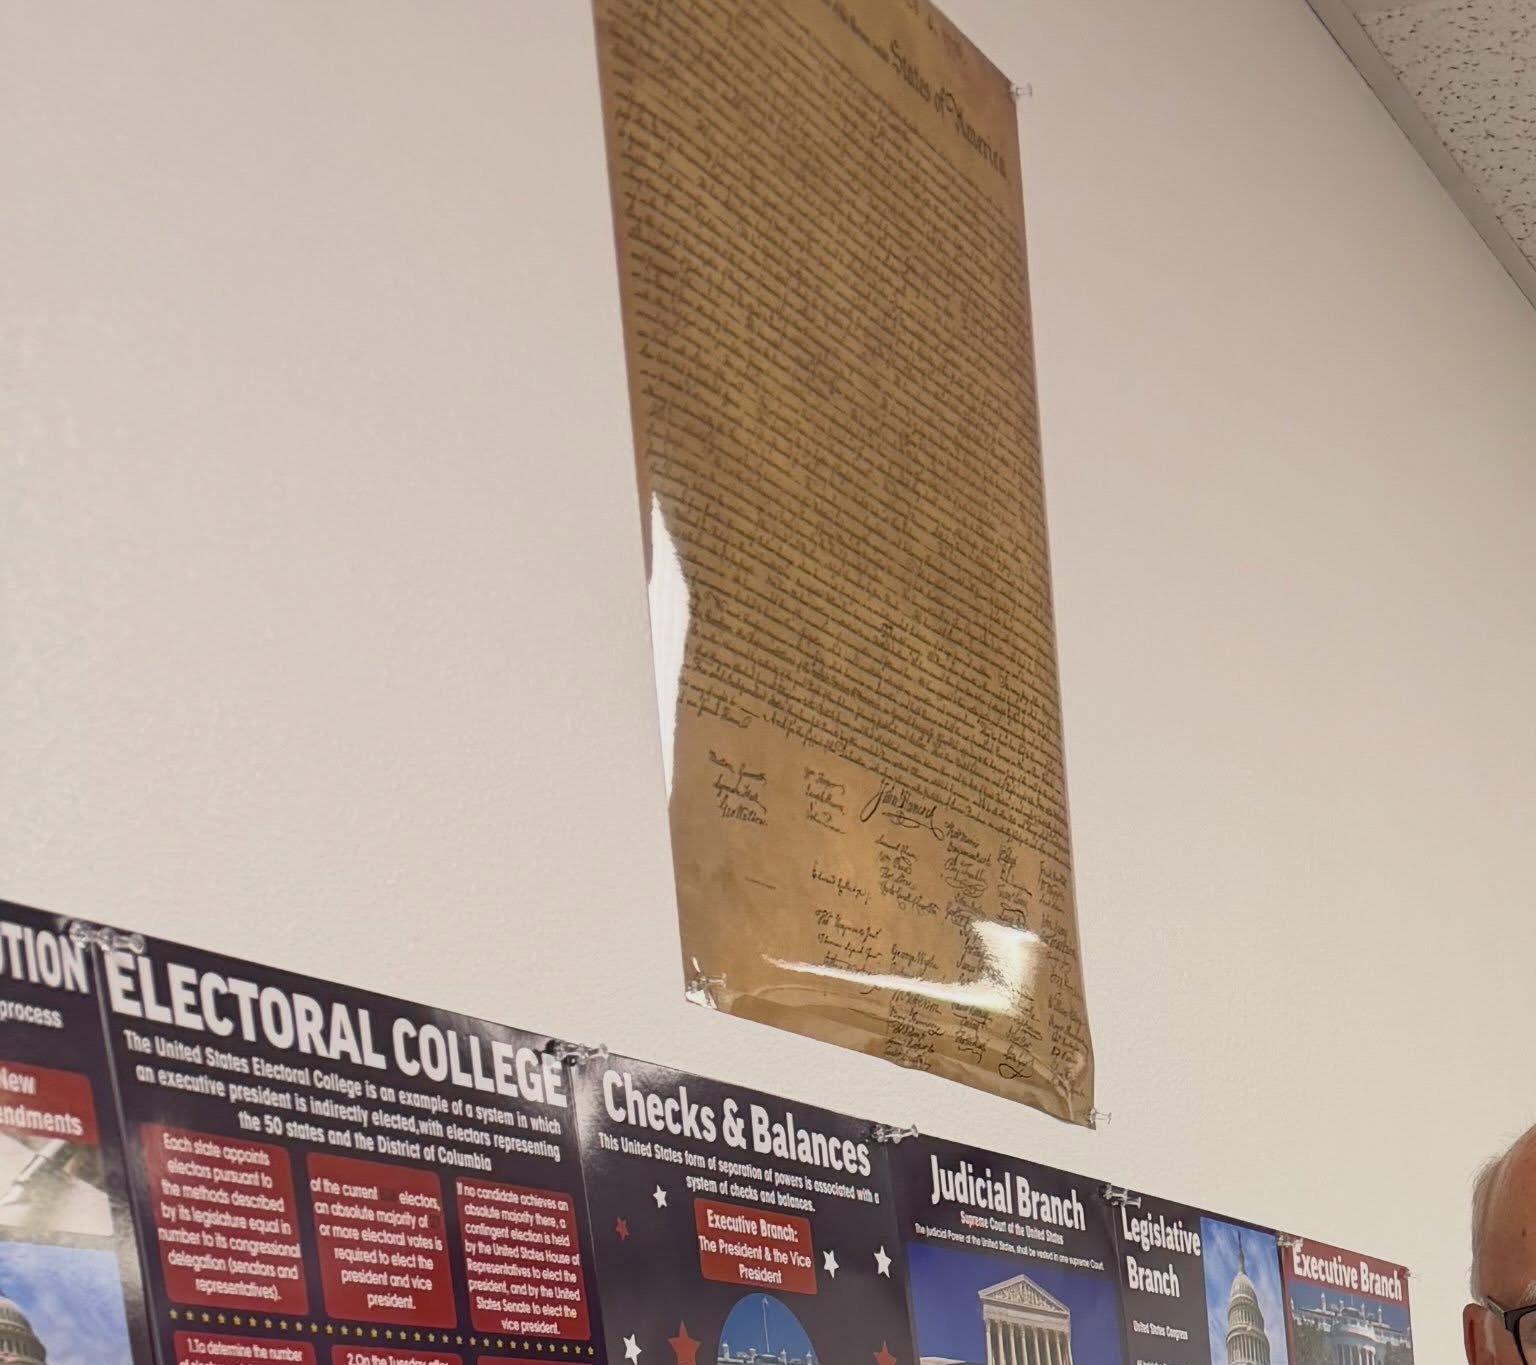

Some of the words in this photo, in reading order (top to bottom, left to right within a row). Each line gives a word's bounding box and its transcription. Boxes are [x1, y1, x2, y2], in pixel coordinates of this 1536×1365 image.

[0, 920, 89, 994] TION
[104, 951, 387, 1070] ELECTORAL
[392, 1017, 568, 1108] COLLEGE
[122, 1028, 152, 1054] The
[154, 1035, 202, 1064] United
[204, 1046, 250, 1074] States
[251, 1055, 311, 1086] Electoral
[312, 1068, 362, 1098] College
[364, 1079, 377, 1099] is
[379, 1085, 396, 1102] an
[397, 1089, 449, 1114] example
[450, 1098, 463, 1116] of
[464, 1103, 473, 1118] a
[474, 1105, 514, 1126] system
[515, 1110, 528, 1129] in
[529, 1114, 562, 1135] which
[0, 1105, 84, 1136] endments
[135, 1064, 156, 1083] an
[157, 1068, 226, 1097] executive
[228, 1082, 292, 1109] president
[293, 1092, 307, 1112] is
[309, 1095, 368, 1127] indirectly
[445, 1122, 491, 1146] electors
[492, 1133, 561, 1162] representing
[237, 1110, 261, 1131] the
[263, 1113, 283, 1135] 50
[285, 1120, 325, 1143] states
[326, 1129, 352, 1147] and
[353, 1131, 374, 1151] the
[376, 1134, 420, 1159] District
[422, 1144, 435, 1161] of
[437, 1145, 492, 1171] Columbia
[602, 1070, 717, 1143] Checks
[722, 1098, 746, 1150] &
[750, 1103, 871, 1177] Balances
[596, 1130, 619, 1151] This
[620, 1135, 652, 1157] United
[653, 1143, 683, 1164] States
[683, 1149, 705, 1168] form
[706, 1155, 716, 1171] of
[717, 1159, 762, 1180] separation
[763, 1167, 772, 1182] of
[773, 1171, 803, 1189] powers
[803, 1175, 813, 1191] is
[813, 1179, 855, 1199] associated
[855, 1187, 873, 1203] with
[873, 1191, 879, 1204] a
[685, 1174, 718, 1193] system
[718, 1180, 728, 1195] of
[729, 1182, 759, 1201] checks
[759, 1189, 776, 1204] and
[776, 1190, 816, 1212] balances.
[930, 1154, 1013, 1214] Judicial
[1015, 1175, 1086, 1231] Branch
[697, 1234, 717, 1253] The
[718, 1237, 762, 1260] President
[763, 1246, 772, 1261] &
[772, 1247, 788, 1264] the
[788, 1250, 812, 1268] Vice
[706, 1208, 757, 1235] Executive
[759, 1218, 798, 1242] Branch:
[1121, 1206, 1201, 1256] Legislative
[738, 1262, 782, 1284] President
[1127, 1255, 1180, 1298] Branch
[1293, 1246, 1358, 1290] Executive
[1360, 1262, 1402, 1301] Branch
